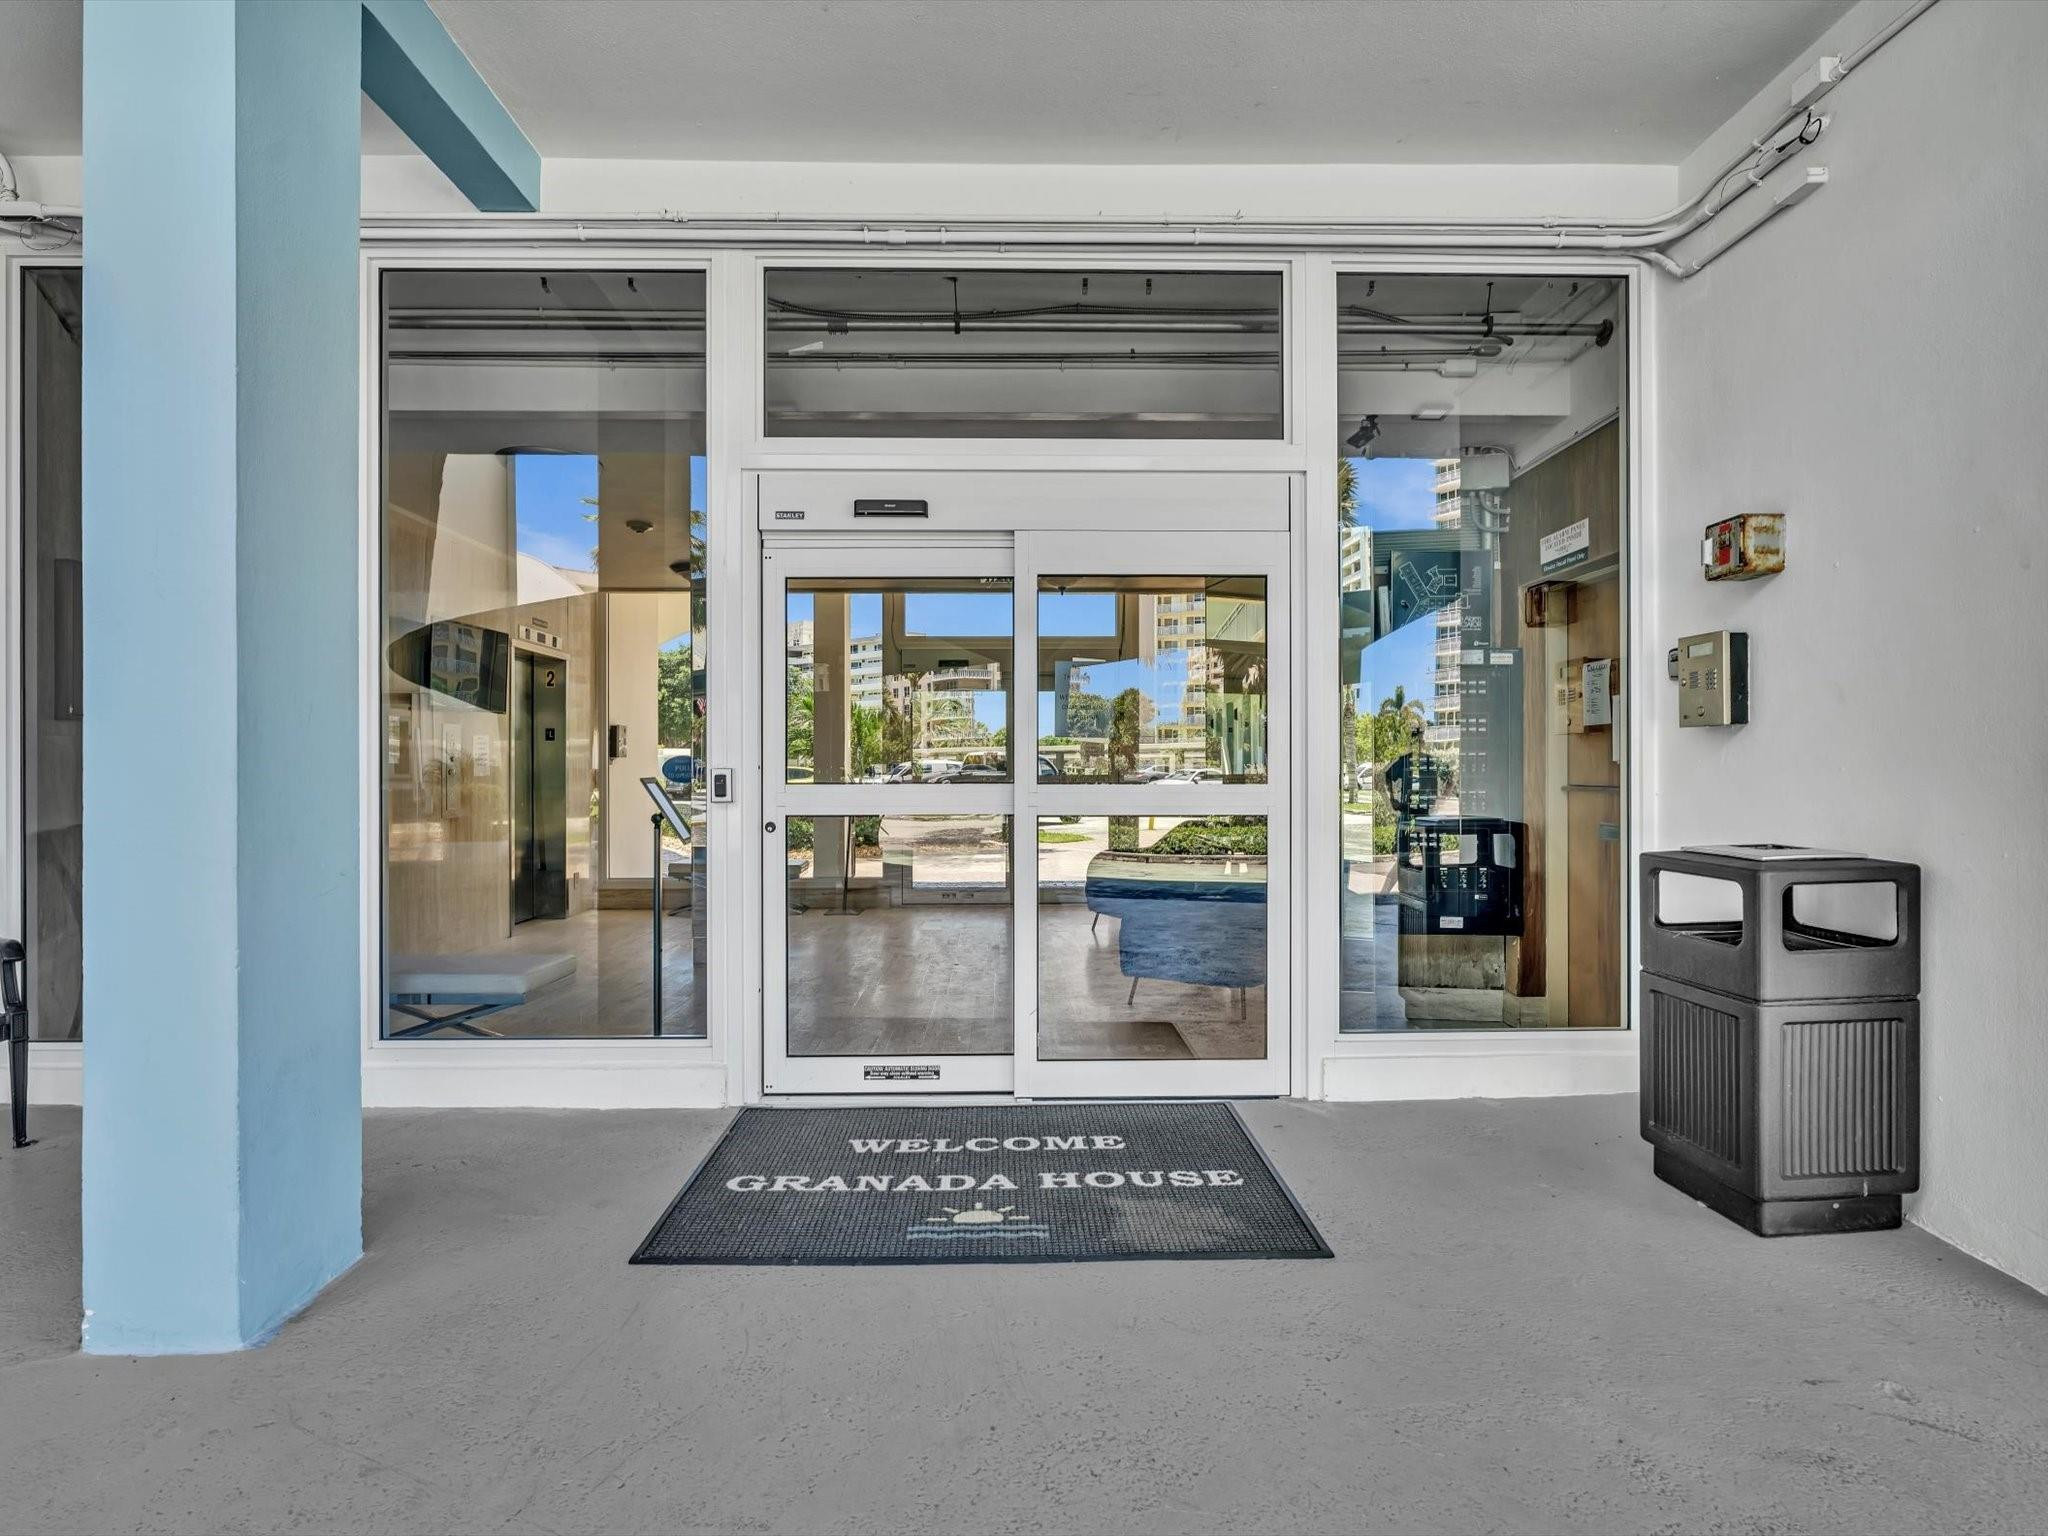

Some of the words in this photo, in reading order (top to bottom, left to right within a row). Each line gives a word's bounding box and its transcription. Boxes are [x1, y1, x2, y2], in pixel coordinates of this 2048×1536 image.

[776, 511, 804, 519] STANLEY
[546, 671, 555, 687] 2
[849, 1135, 1127, 1154] WELCOME
[725, 1173, 1019, 1192] GRANADA
[1037, 1169, 1245, 1189] HOUSE
